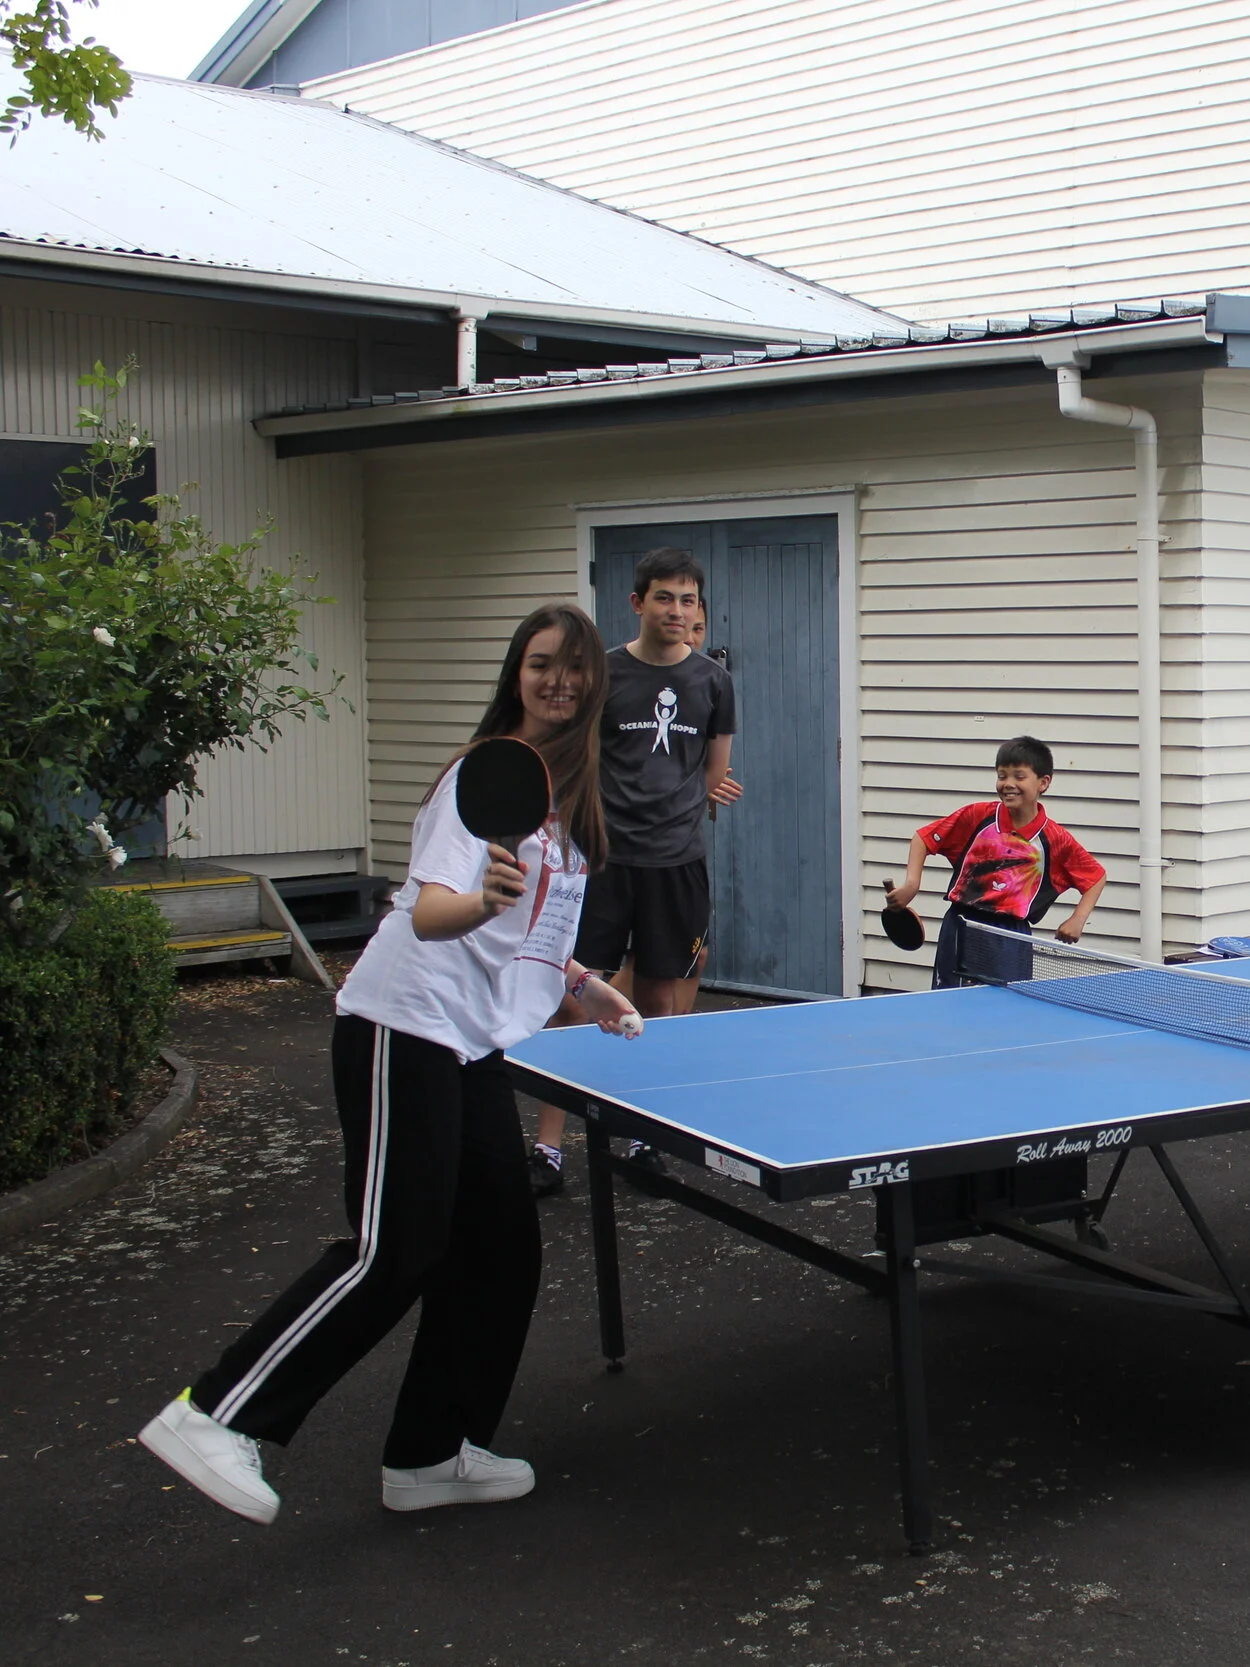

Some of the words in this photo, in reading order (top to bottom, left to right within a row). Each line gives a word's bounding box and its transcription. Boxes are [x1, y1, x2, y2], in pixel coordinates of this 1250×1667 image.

[619, 721, 658, 731] OCEANIA
[670, 723, 698, 735] HOPES
[1016, 1143, 1048, 1164] Roll
[1050, 1137, 1092, 1158] Away
[1095, 1126, 1133, 1149] 2000
[849, 1160, 910, 1190] STAG
